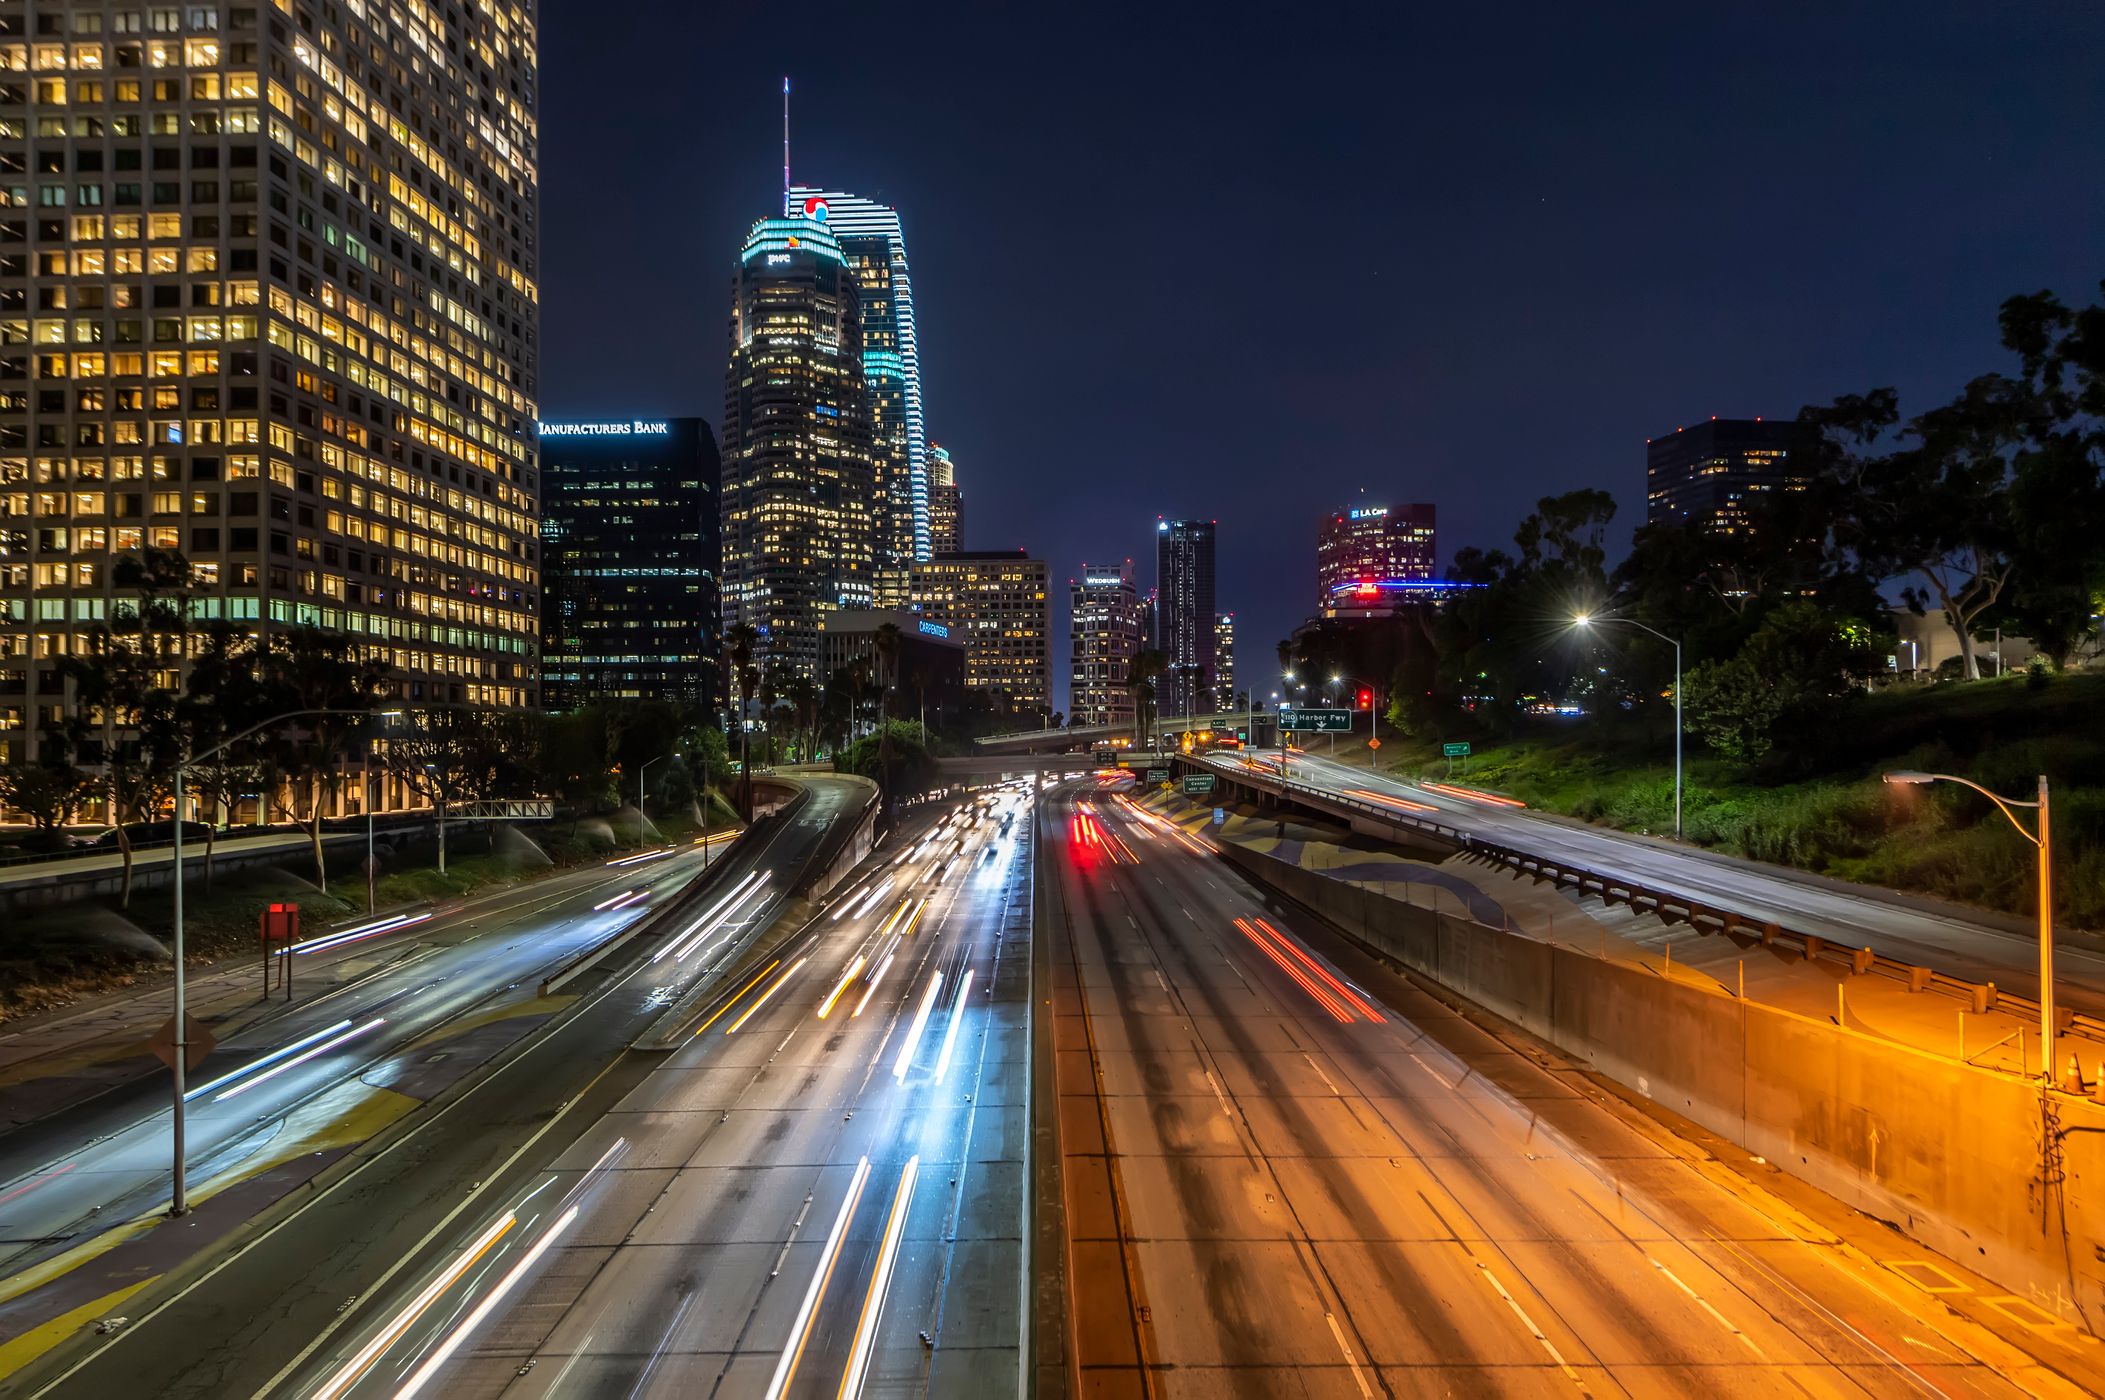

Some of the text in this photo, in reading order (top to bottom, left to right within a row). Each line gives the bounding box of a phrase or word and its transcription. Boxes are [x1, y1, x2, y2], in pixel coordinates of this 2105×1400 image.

[768, 254, 790, 265] pwc
[1372, 507, 1388, 516] Care
[919, 620, 947, 638] CARPENTERS
[1330, 714, 1346, 722] Fwy
